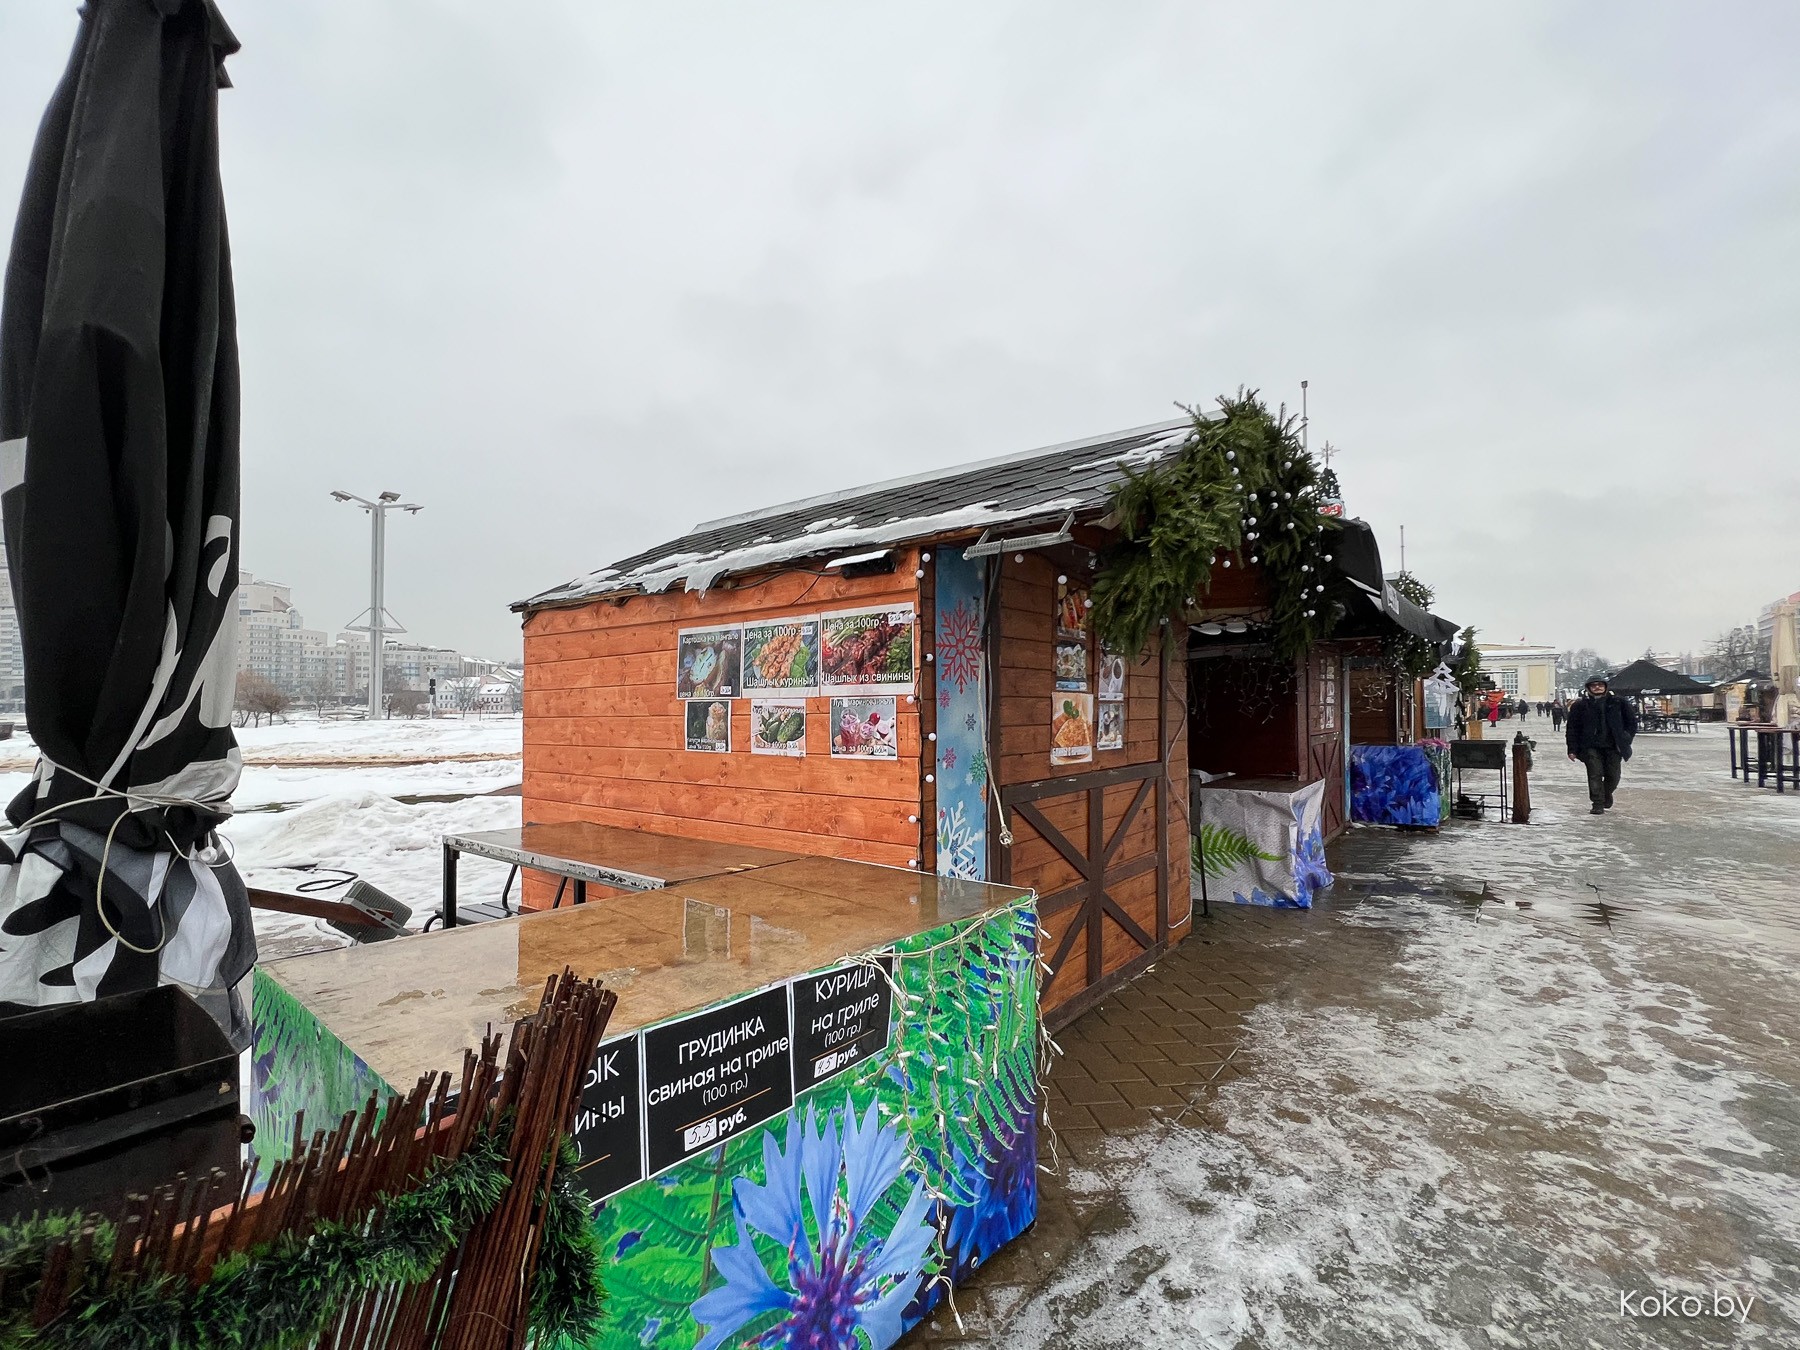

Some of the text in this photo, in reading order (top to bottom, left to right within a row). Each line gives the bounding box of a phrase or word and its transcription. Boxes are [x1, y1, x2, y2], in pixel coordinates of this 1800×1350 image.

[745, 629, 762, 641] Цена
[763, 630, 772, 638] за
[824, 621, 843, 631] Цена
[746, 675, 814, 688] Шашлык куриный
[822, 671, 911, 683] Шашлык из свинины
[815, 966, 876, 1003] КУРИЦА
[811, 993, 880, 1034] на гриле
[678, 1016, 766, 1064] ГРУДИНКА
[824, 1019, 862, 1048] (100 гр.)
[837, 1043, 858, 1068] руб.
[648, 1036, 789, 1106] свиная на гриле
[703, 1072, 748, 1106] (100 гр.)
[718, 1107, 748, 1136] руб.
